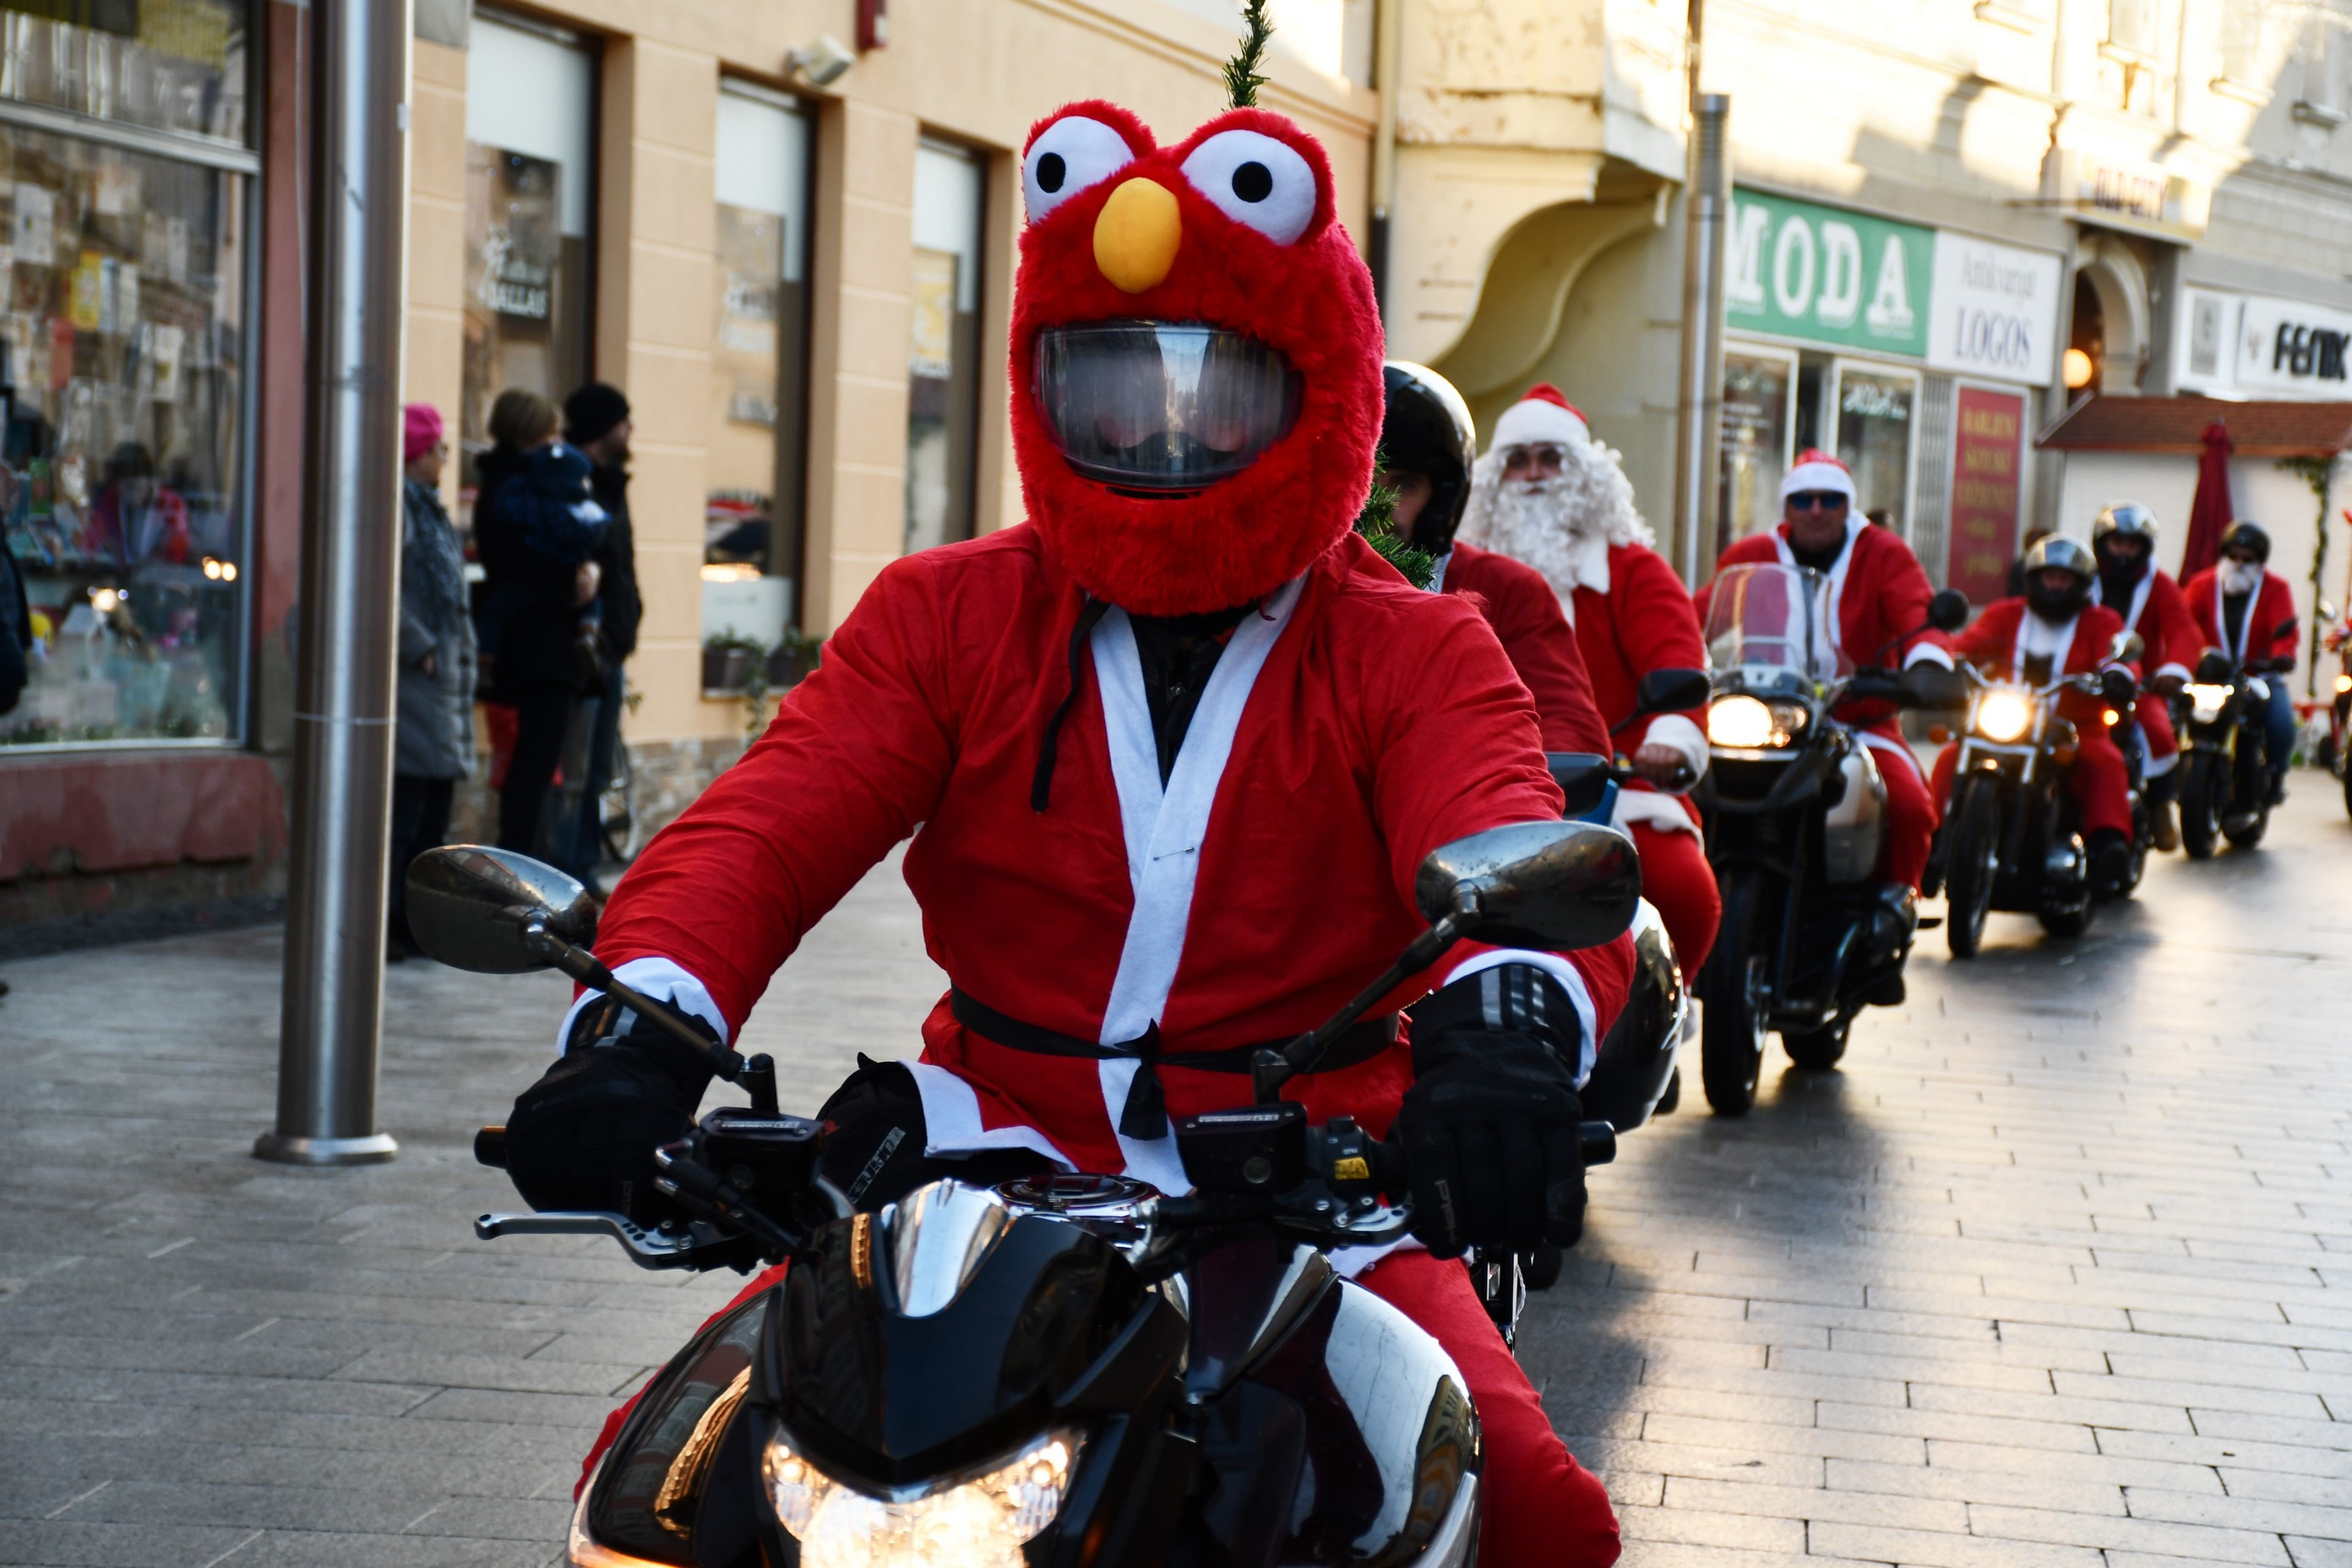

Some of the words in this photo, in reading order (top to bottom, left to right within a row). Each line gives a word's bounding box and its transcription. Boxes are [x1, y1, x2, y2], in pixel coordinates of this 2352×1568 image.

[1724, 199, 1914, 335] MODA
[487, 281, 547, 318] DALLAS
[1954, 305, 2033, 370] LOGOS
[2273, 319, 2351, 382] FENIX
